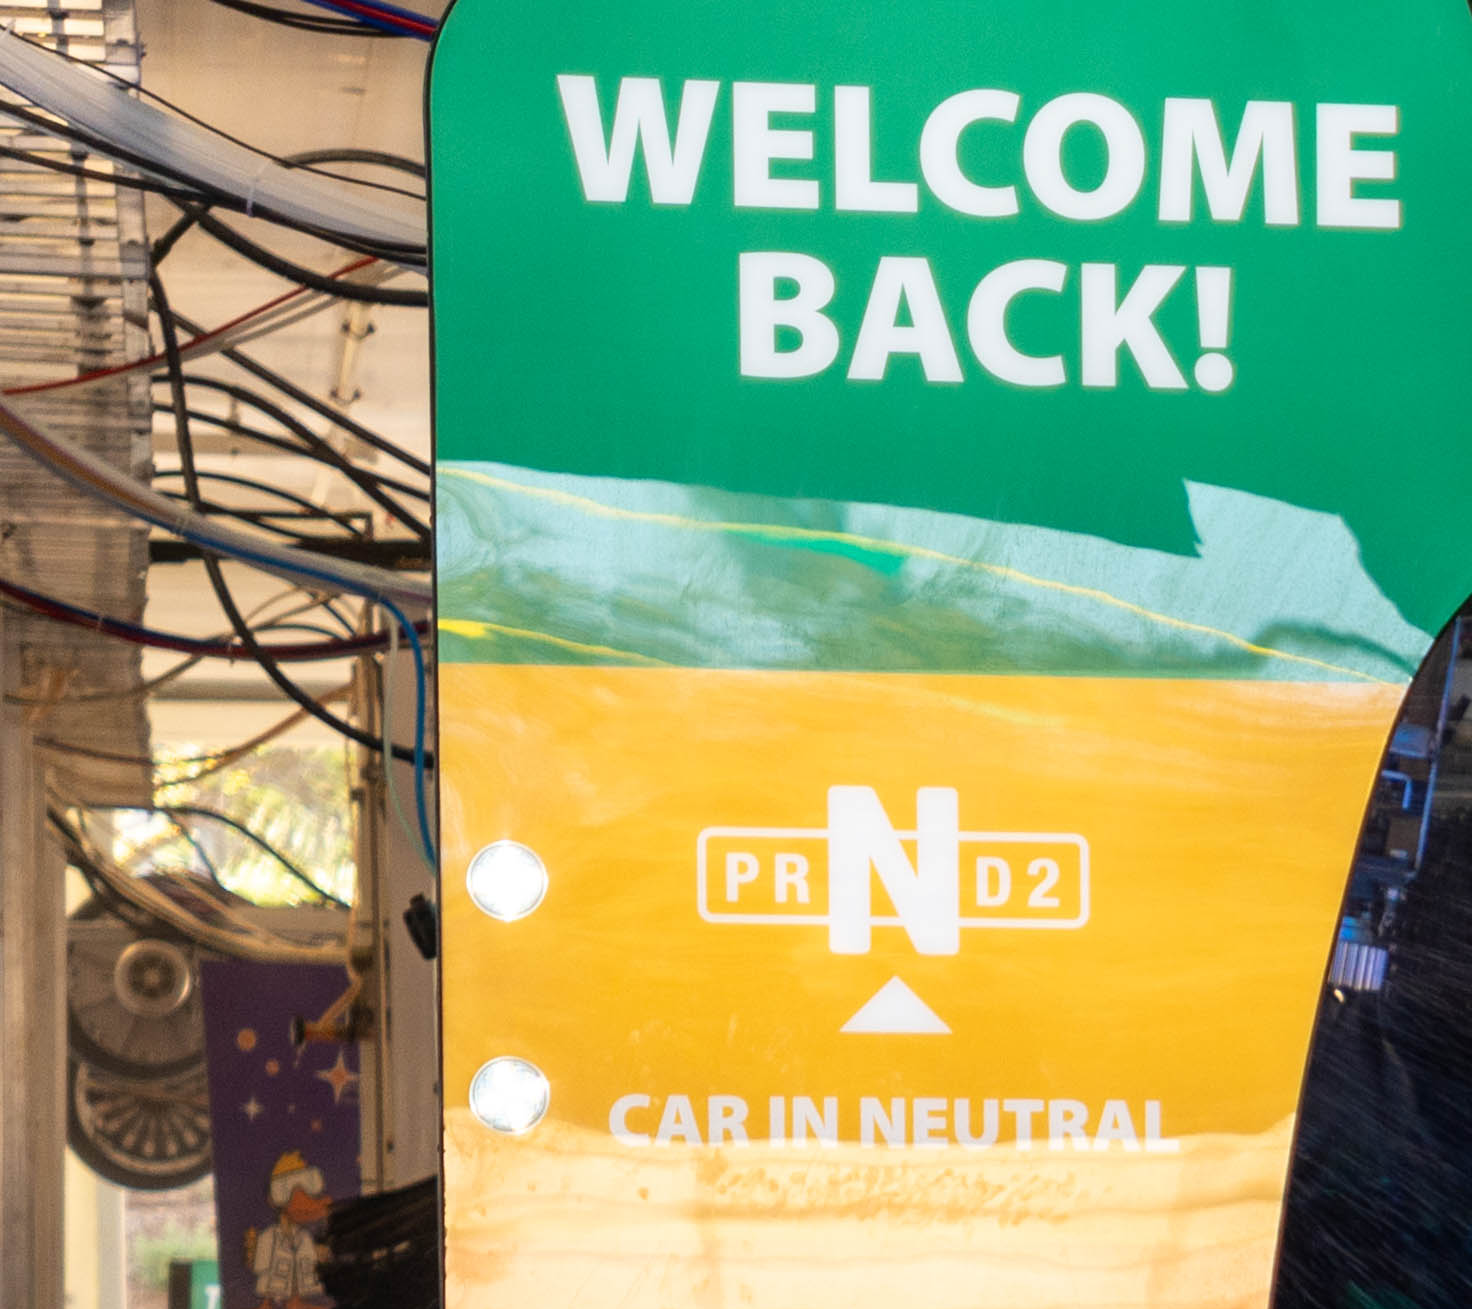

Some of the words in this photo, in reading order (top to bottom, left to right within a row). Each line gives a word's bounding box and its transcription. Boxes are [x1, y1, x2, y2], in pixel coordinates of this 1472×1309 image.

[557, 73, 1402, 230] WELCOME
[737, 251, 1235, 391] BACK!
[608, 1094, 749, 1148] CAR
[768, 1096, 838, 1148] IN
[861, 1097, 1179, 1152] NEUTRAL
